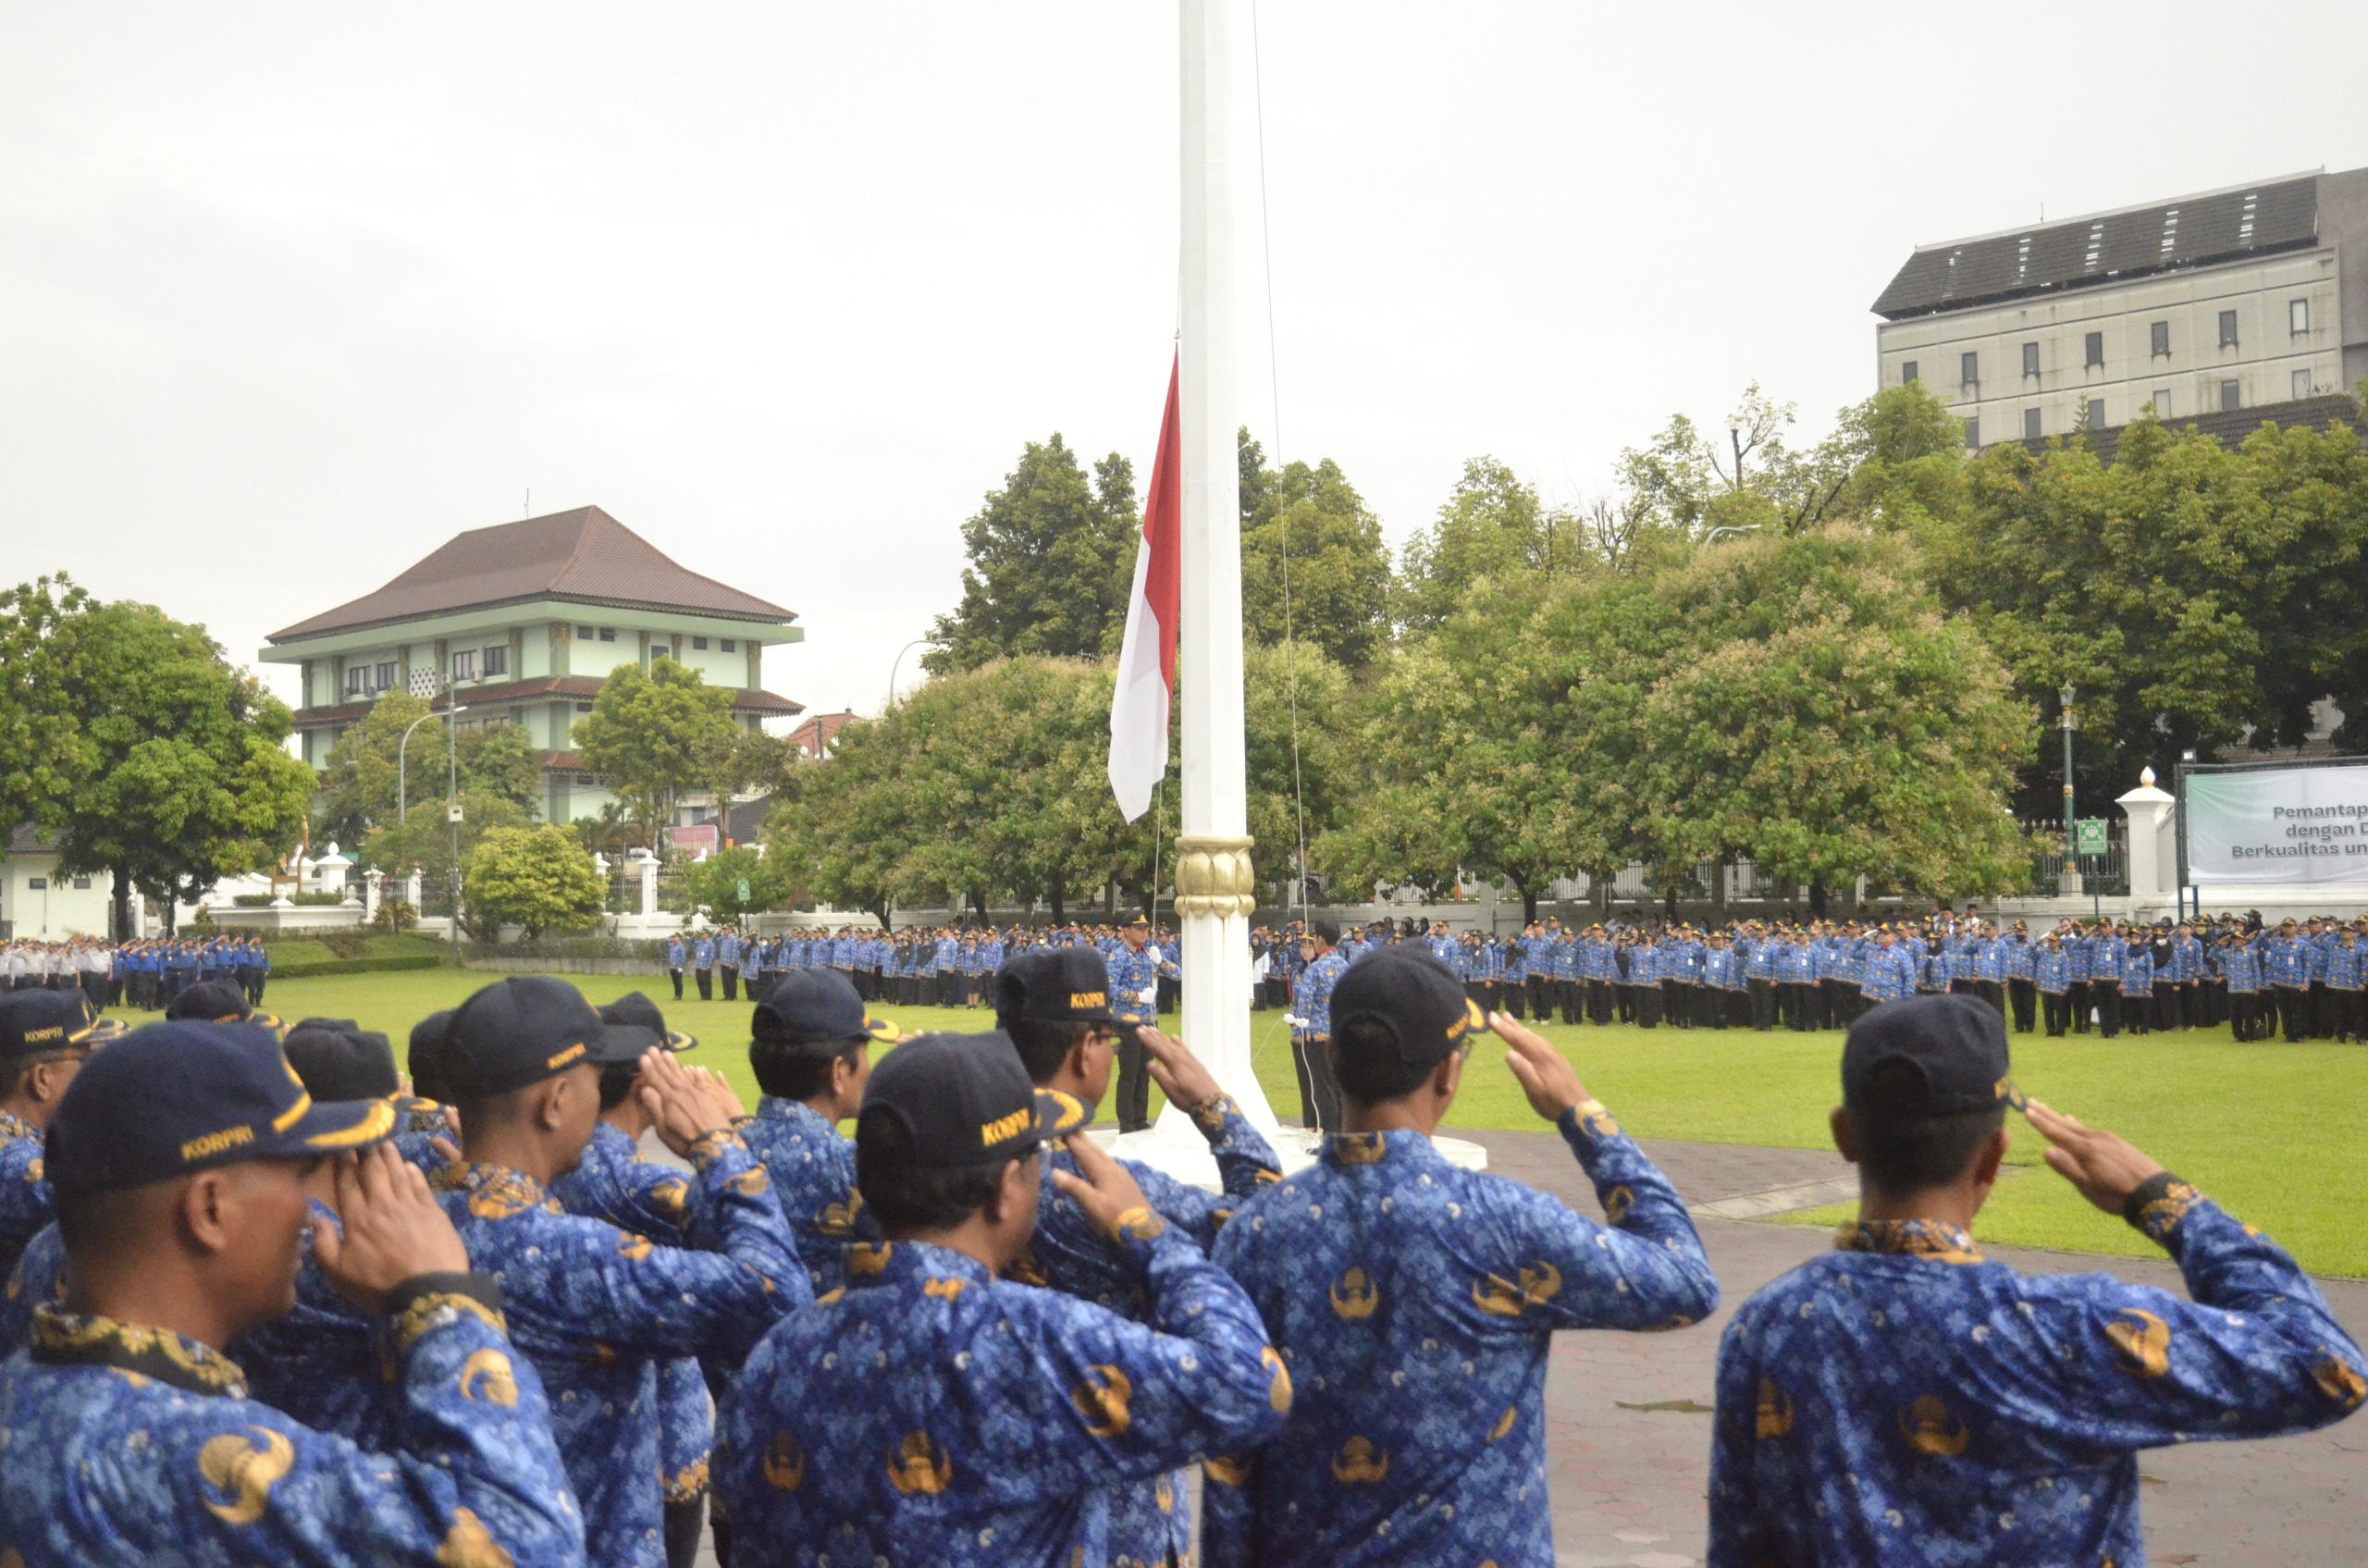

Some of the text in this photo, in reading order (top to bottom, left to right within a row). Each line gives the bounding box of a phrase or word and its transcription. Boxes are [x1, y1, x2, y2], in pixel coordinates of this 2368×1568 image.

[2273, 803, 2368, 820] Pemantap
[2285, 823, 2356, 843] dengan
[2231, 841, 2368, 859] Berkualitas un
[23, 1026, 64, 1043] KORPRI
[181, 1125, 254, 1162] KORPRI
